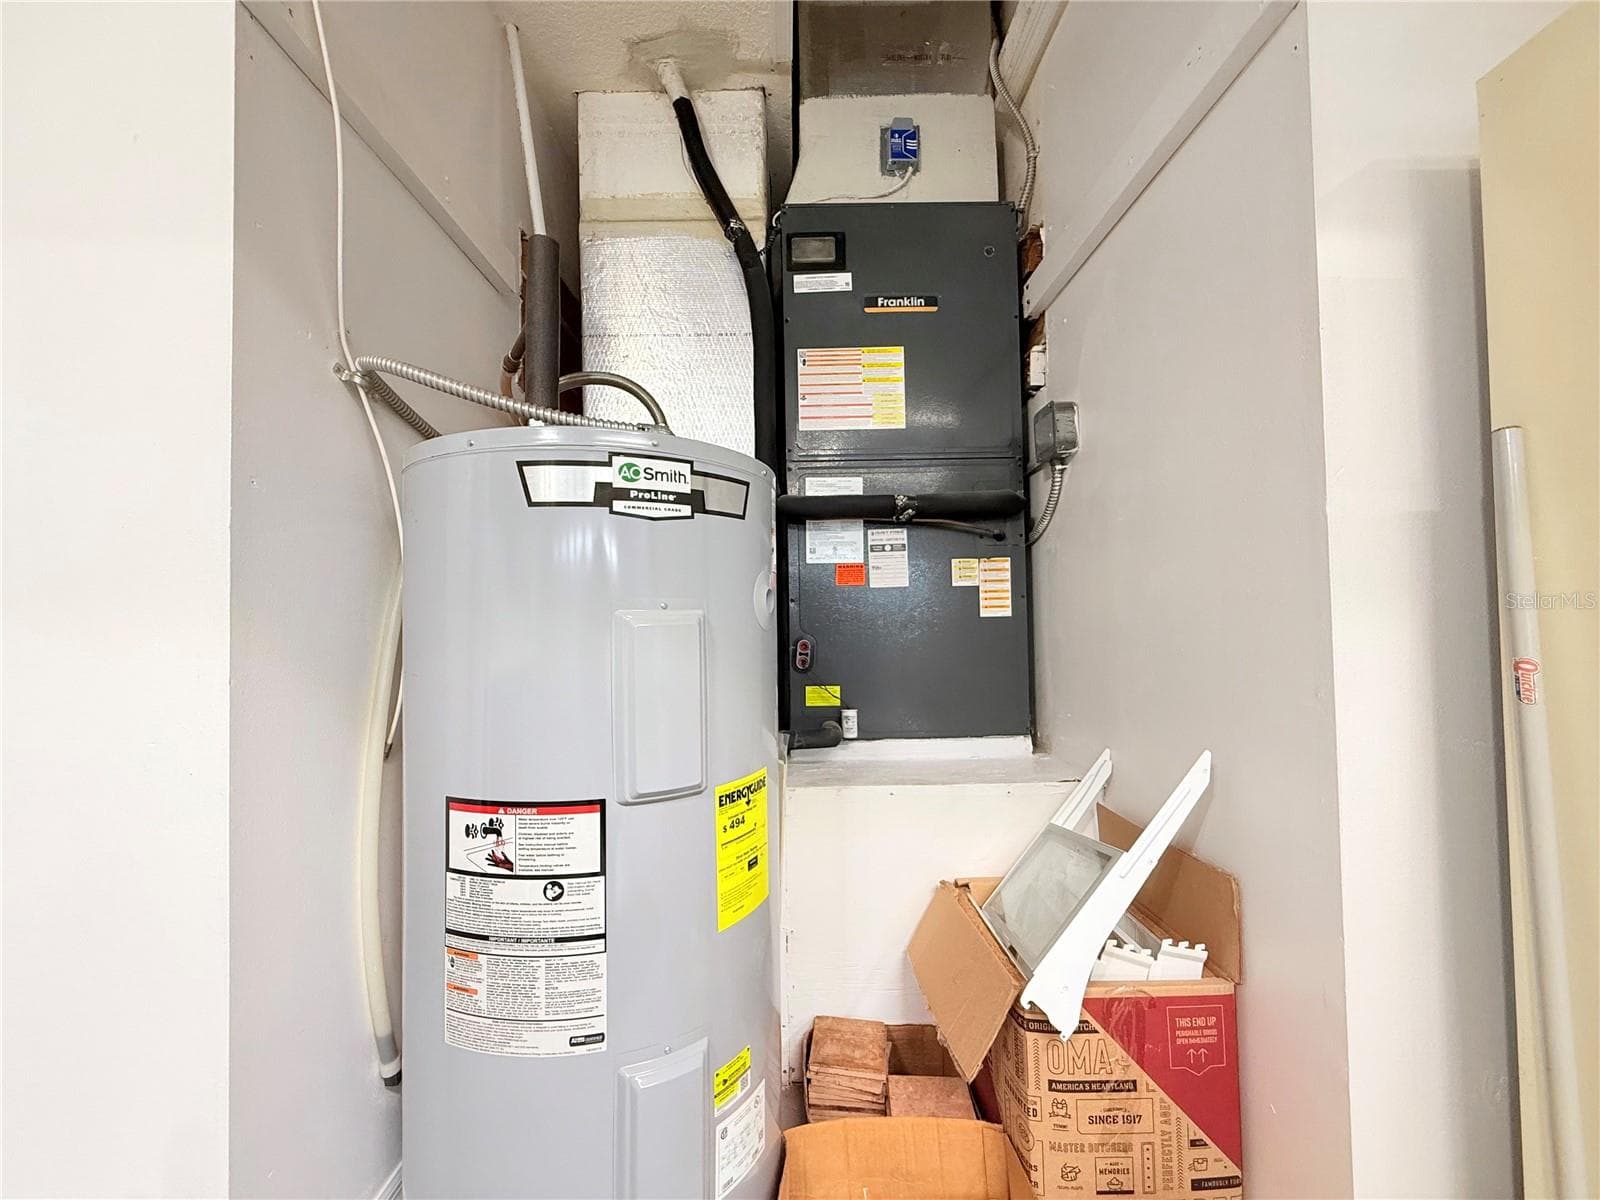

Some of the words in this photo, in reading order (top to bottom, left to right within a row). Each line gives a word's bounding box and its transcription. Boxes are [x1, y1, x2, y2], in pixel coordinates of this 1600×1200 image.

[877, 297, 925, 307] Franklin
[629, 490, 677, 501] ProLine
[623, 504, 662, 512] COMMERCIAL
[1513, 658, 1538, 704] Quickie
[718, 776, 766, 807] ENERGYGUIDE
[506, 807, 538, 815] DANGER
[1029, 1022, 1056, 1031] ORIGI
[1175, 1017, 1192, 1028] THIS
[1192, 1016, 1207, 1027] END
[1207, 1016, 1217, 1026] UP
[1175, 1029, 1203, 1037] PERISHABLE
[1176, 1037, 1189, 1045] OPEN
[1189, 1036, 1218, 1044] IMMEDIATELY
[1046, 1038, 1113, 1075] OMA
[1051, 1081, 1090, 1091] AMERICA'S
[1091, 1081, 1134, 1091] HEARTLAND
[1088, 1114, 1120, 1125] SINCE
[1122, 1114, 1143, 1125] 1917
[1049, 1141, 1086, 1153] MASTER
[1099, 1167, 1130, 1175] MEMORIES
